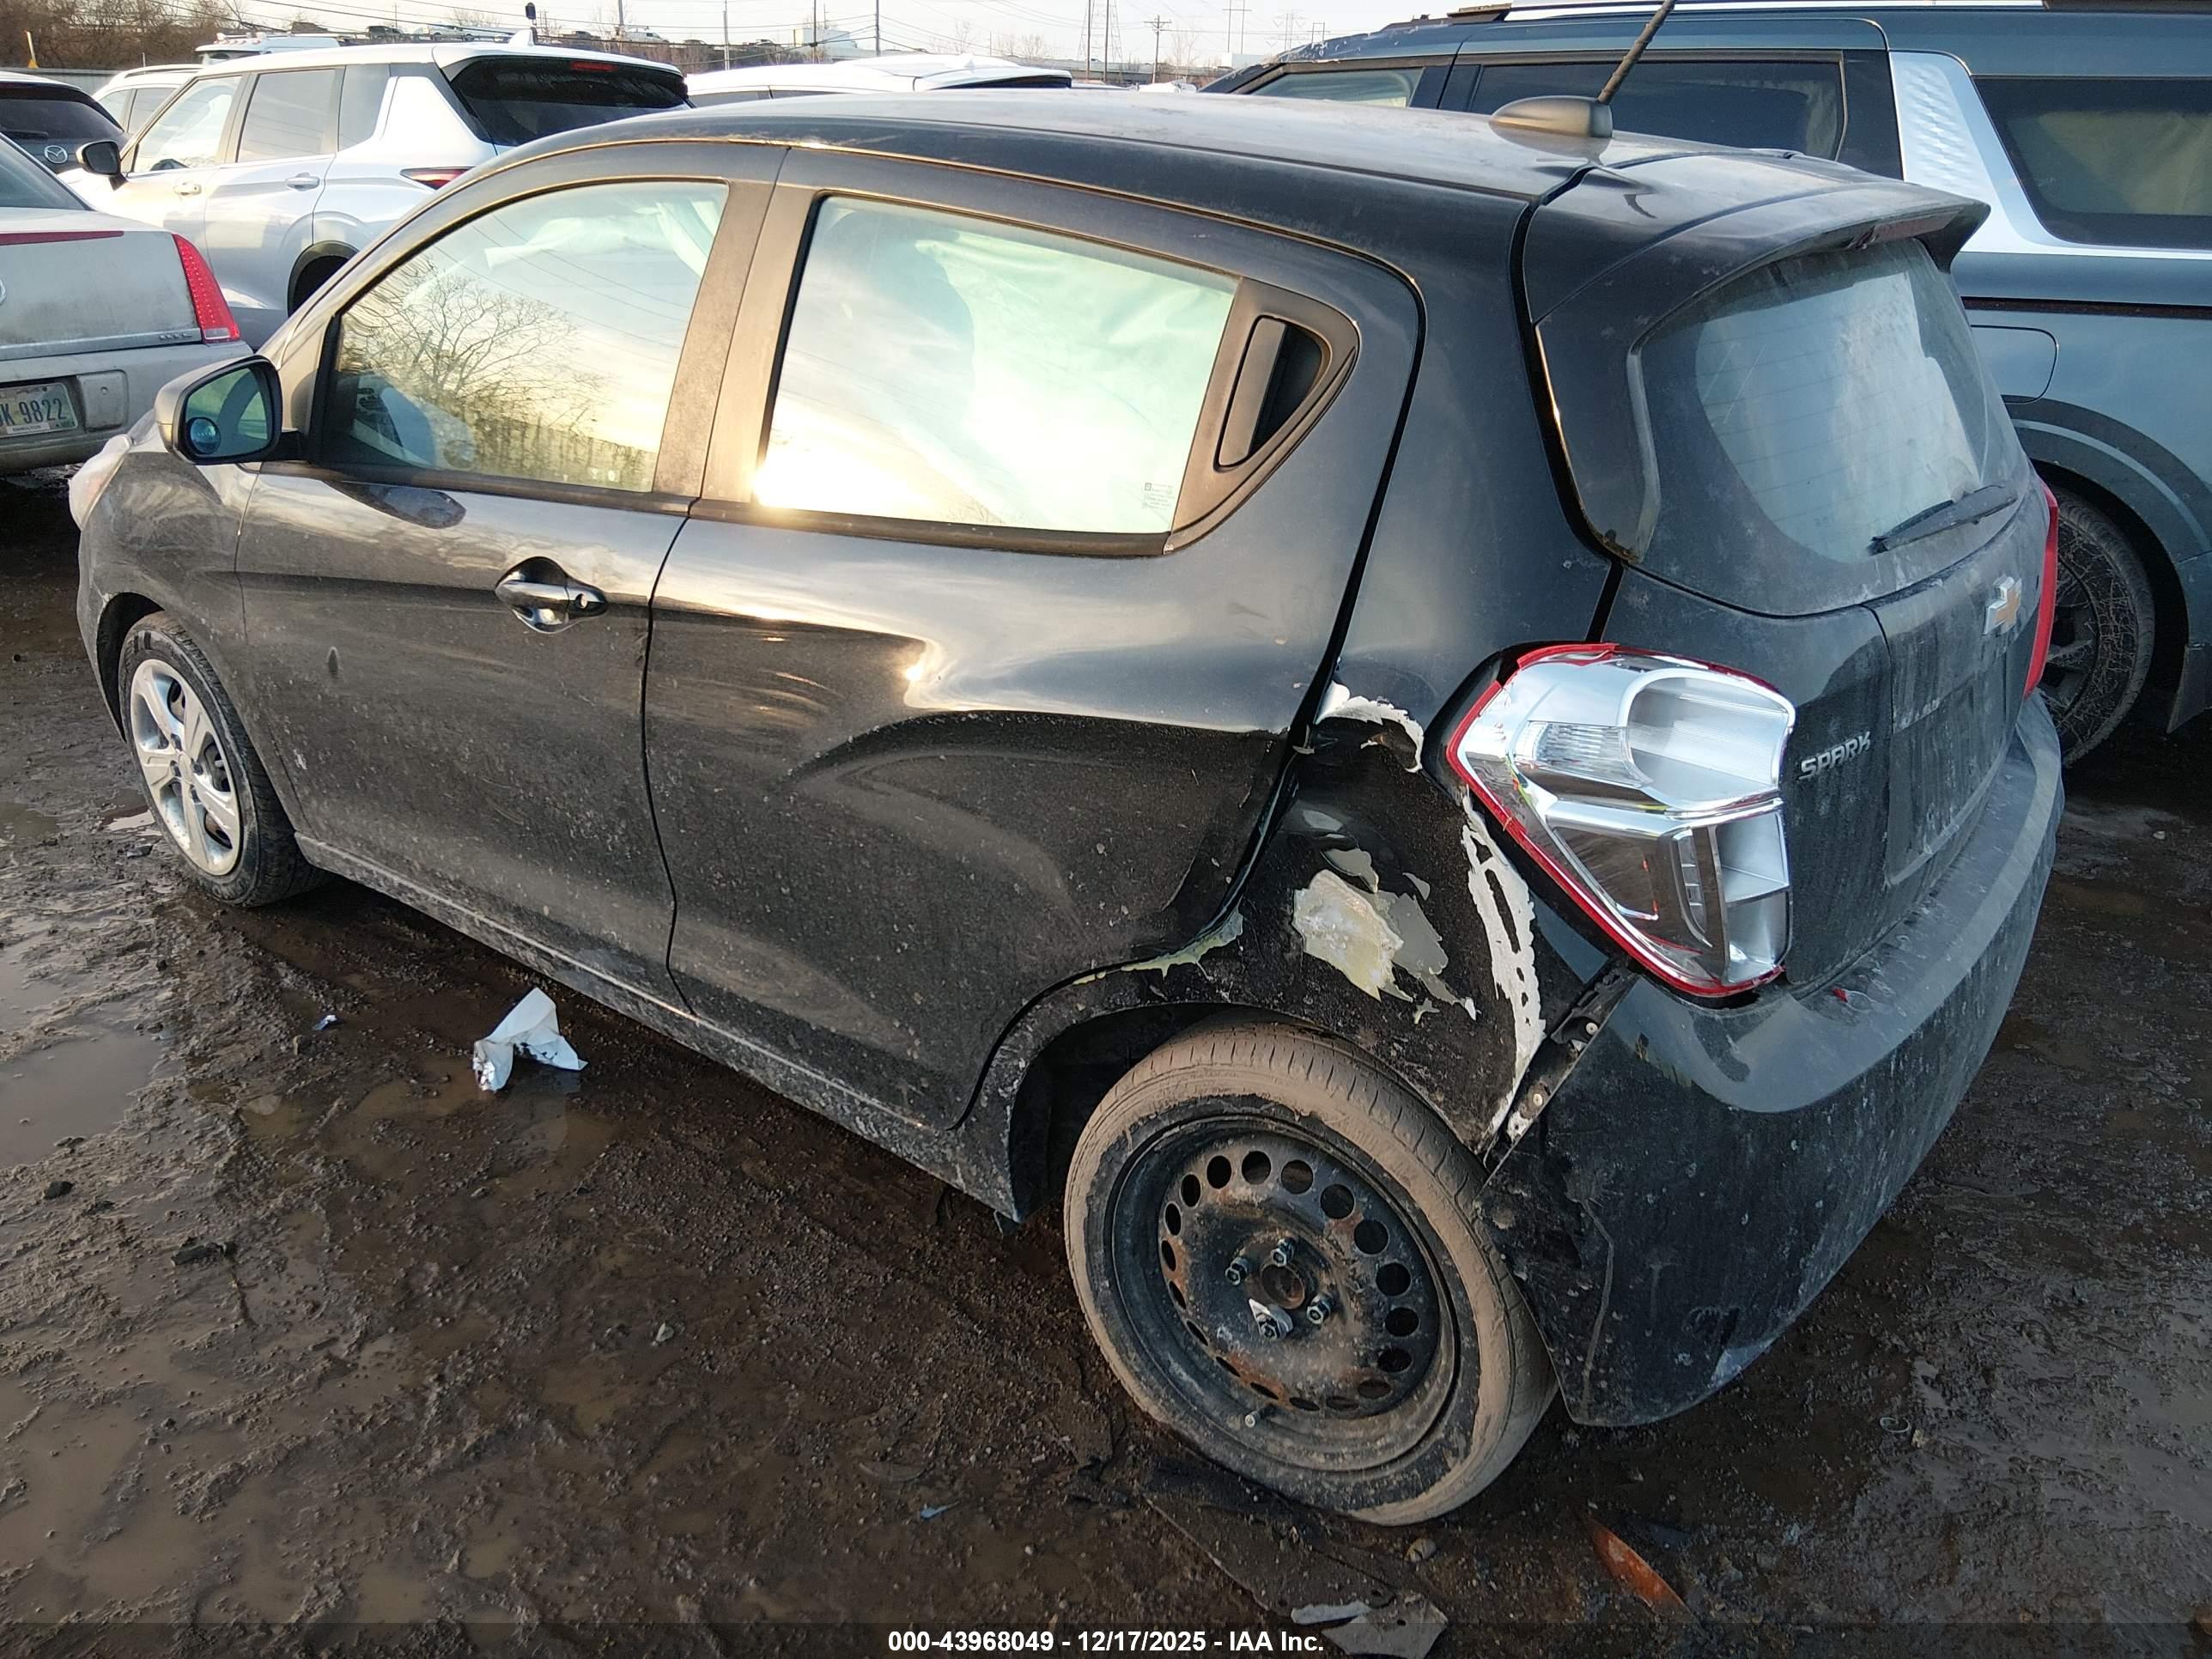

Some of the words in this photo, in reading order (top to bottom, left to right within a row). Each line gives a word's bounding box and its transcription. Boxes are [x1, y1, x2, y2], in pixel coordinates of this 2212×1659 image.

[0, 403, 15, 426] K
[18, 398, 67, 424] 9822
[1798, 731, 1871, 780] SPARK
